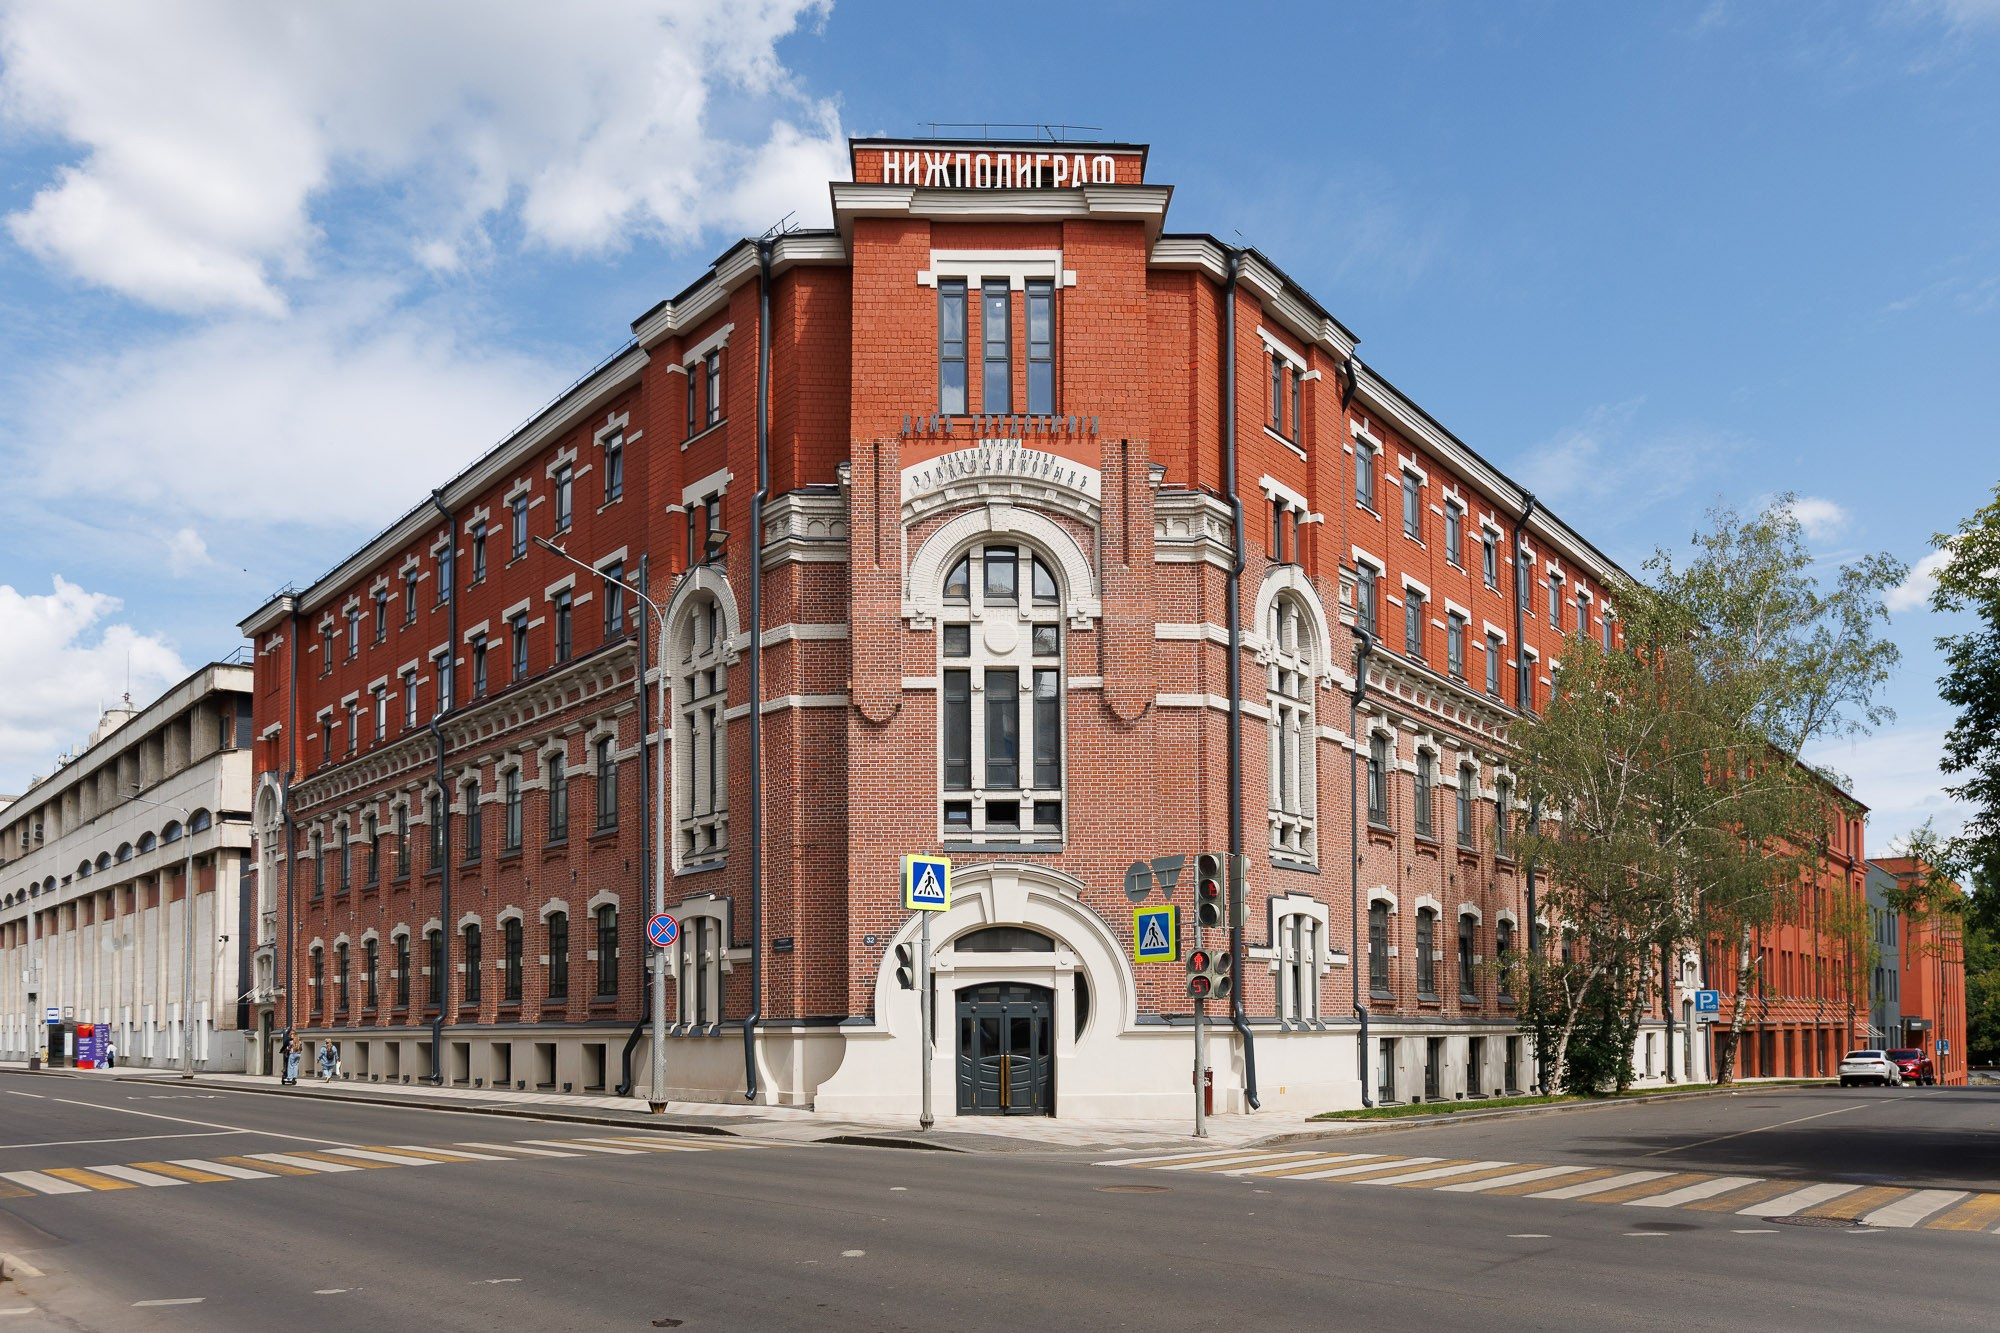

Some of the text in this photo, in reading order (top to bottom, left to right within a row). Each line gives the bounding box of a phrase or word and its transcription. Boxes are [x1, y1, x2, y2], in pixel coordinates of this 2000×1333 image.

[883, 151, 1115, 188] НИЖПОЛИГРАФ
[903, 414, 953, 437] ДОМЪ
[866, 936, 875, 944] 32
[1193, 980, 1208, 993] 57
[1700, 993, 1713, 1009] P
